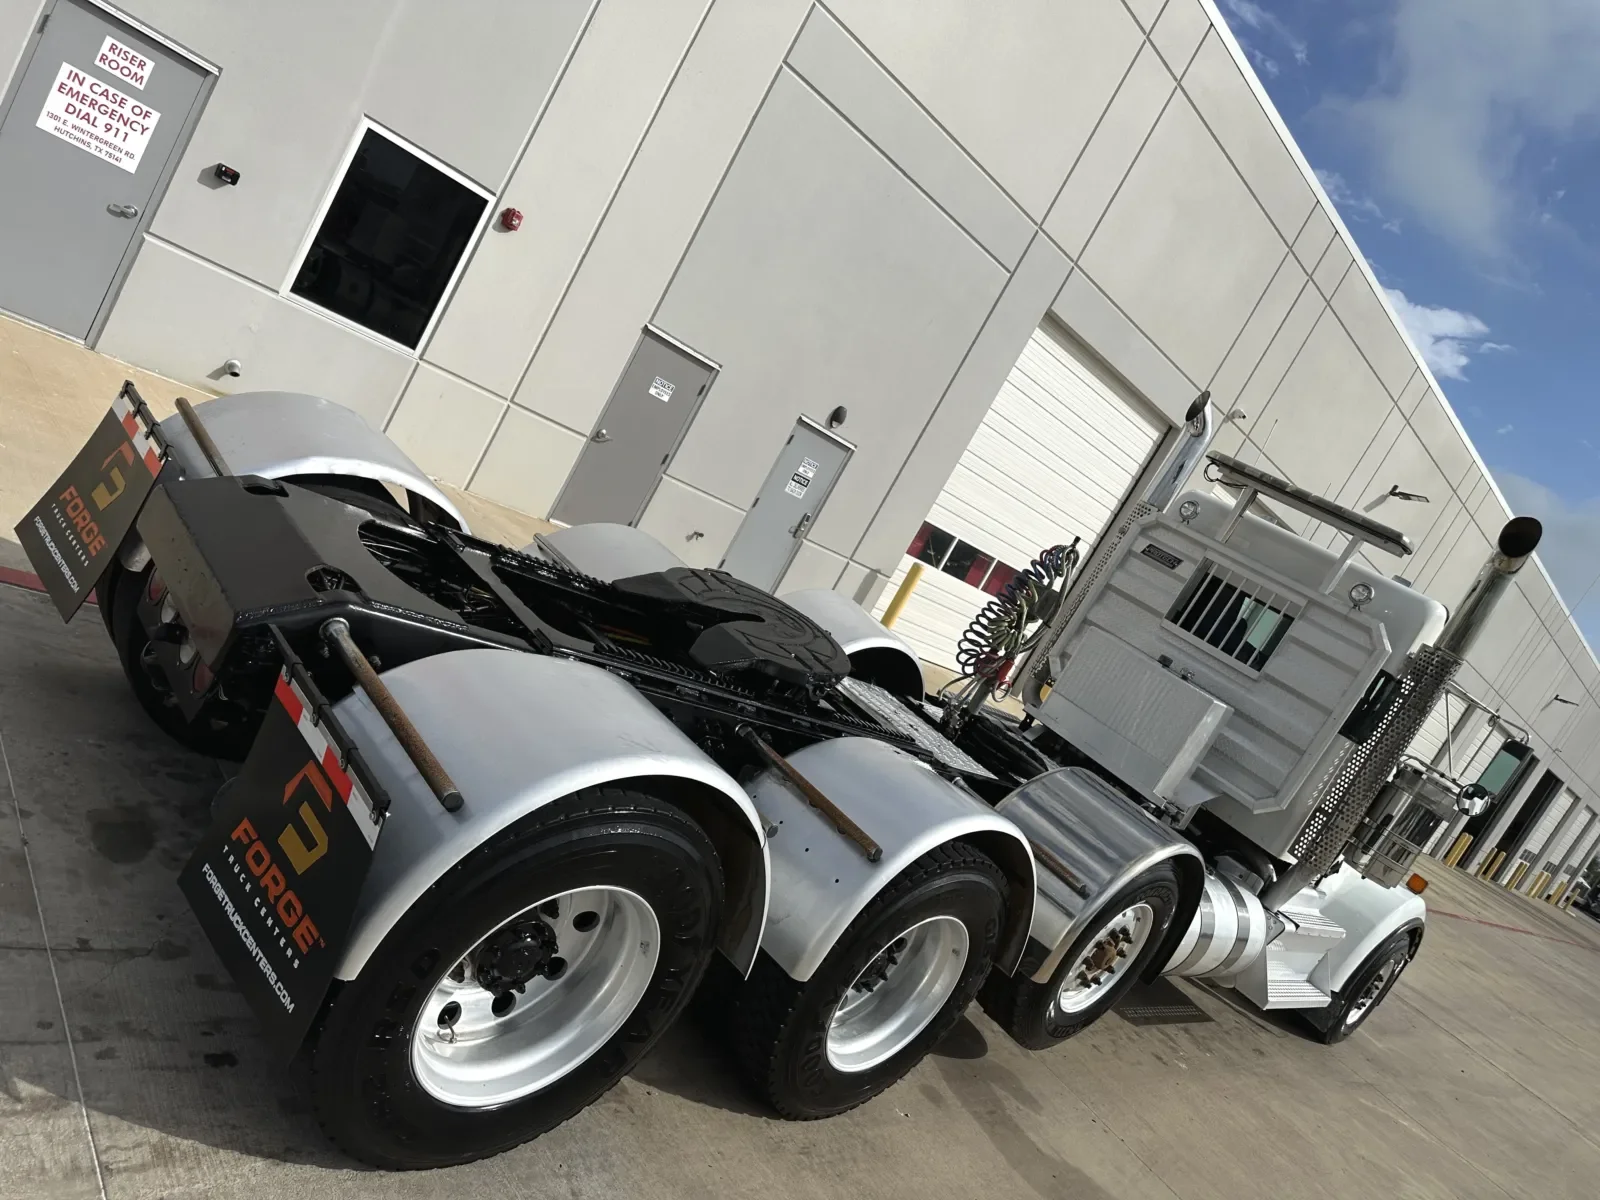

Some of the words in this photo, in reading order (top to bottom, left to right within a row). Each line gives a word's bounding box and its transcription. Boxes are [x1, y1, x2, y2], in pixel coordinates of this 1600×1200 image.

[98, 53, 144, 86] ROOM
[108, 42, 147, 72] RISER
[57, 82, 150, 136] EMERGENCY
[66, 69, 86, 87] IN
[89, 82, 128, 110] CASE
[131, 104, 153, 120] OF
[46, 110, 62, 123] 1301
[62, 118, 68, 126] E.
[71, 123, 124, 154] WINTERGREEN
[123, 150, 136, 160] RD.
[54, 125, 93, 150] HUTCHINS,
[94, 145, 103, 154] TX
[104, 151, 122, 164] 75141
[64, 102, 98, 129] DIAL
[104, 122, 129, 143] 911
[793, 474, 808, 486] NOTICE
[51, 502, 66, 529] TRUCK
[66, 529, 89, 567] CENTERS
[59, 486, 107, 556] FORGE
[33, 516, 80, 594] FORGETRUCKCENTERS.COM
[222, 844, 252, 892] TRUCK
[253, 897, 300, 969] CENTERS
[230, 816, 320, 954] FORGE
[201, 862, 296, 1013] FORGETRUCKCENTERS.COM
